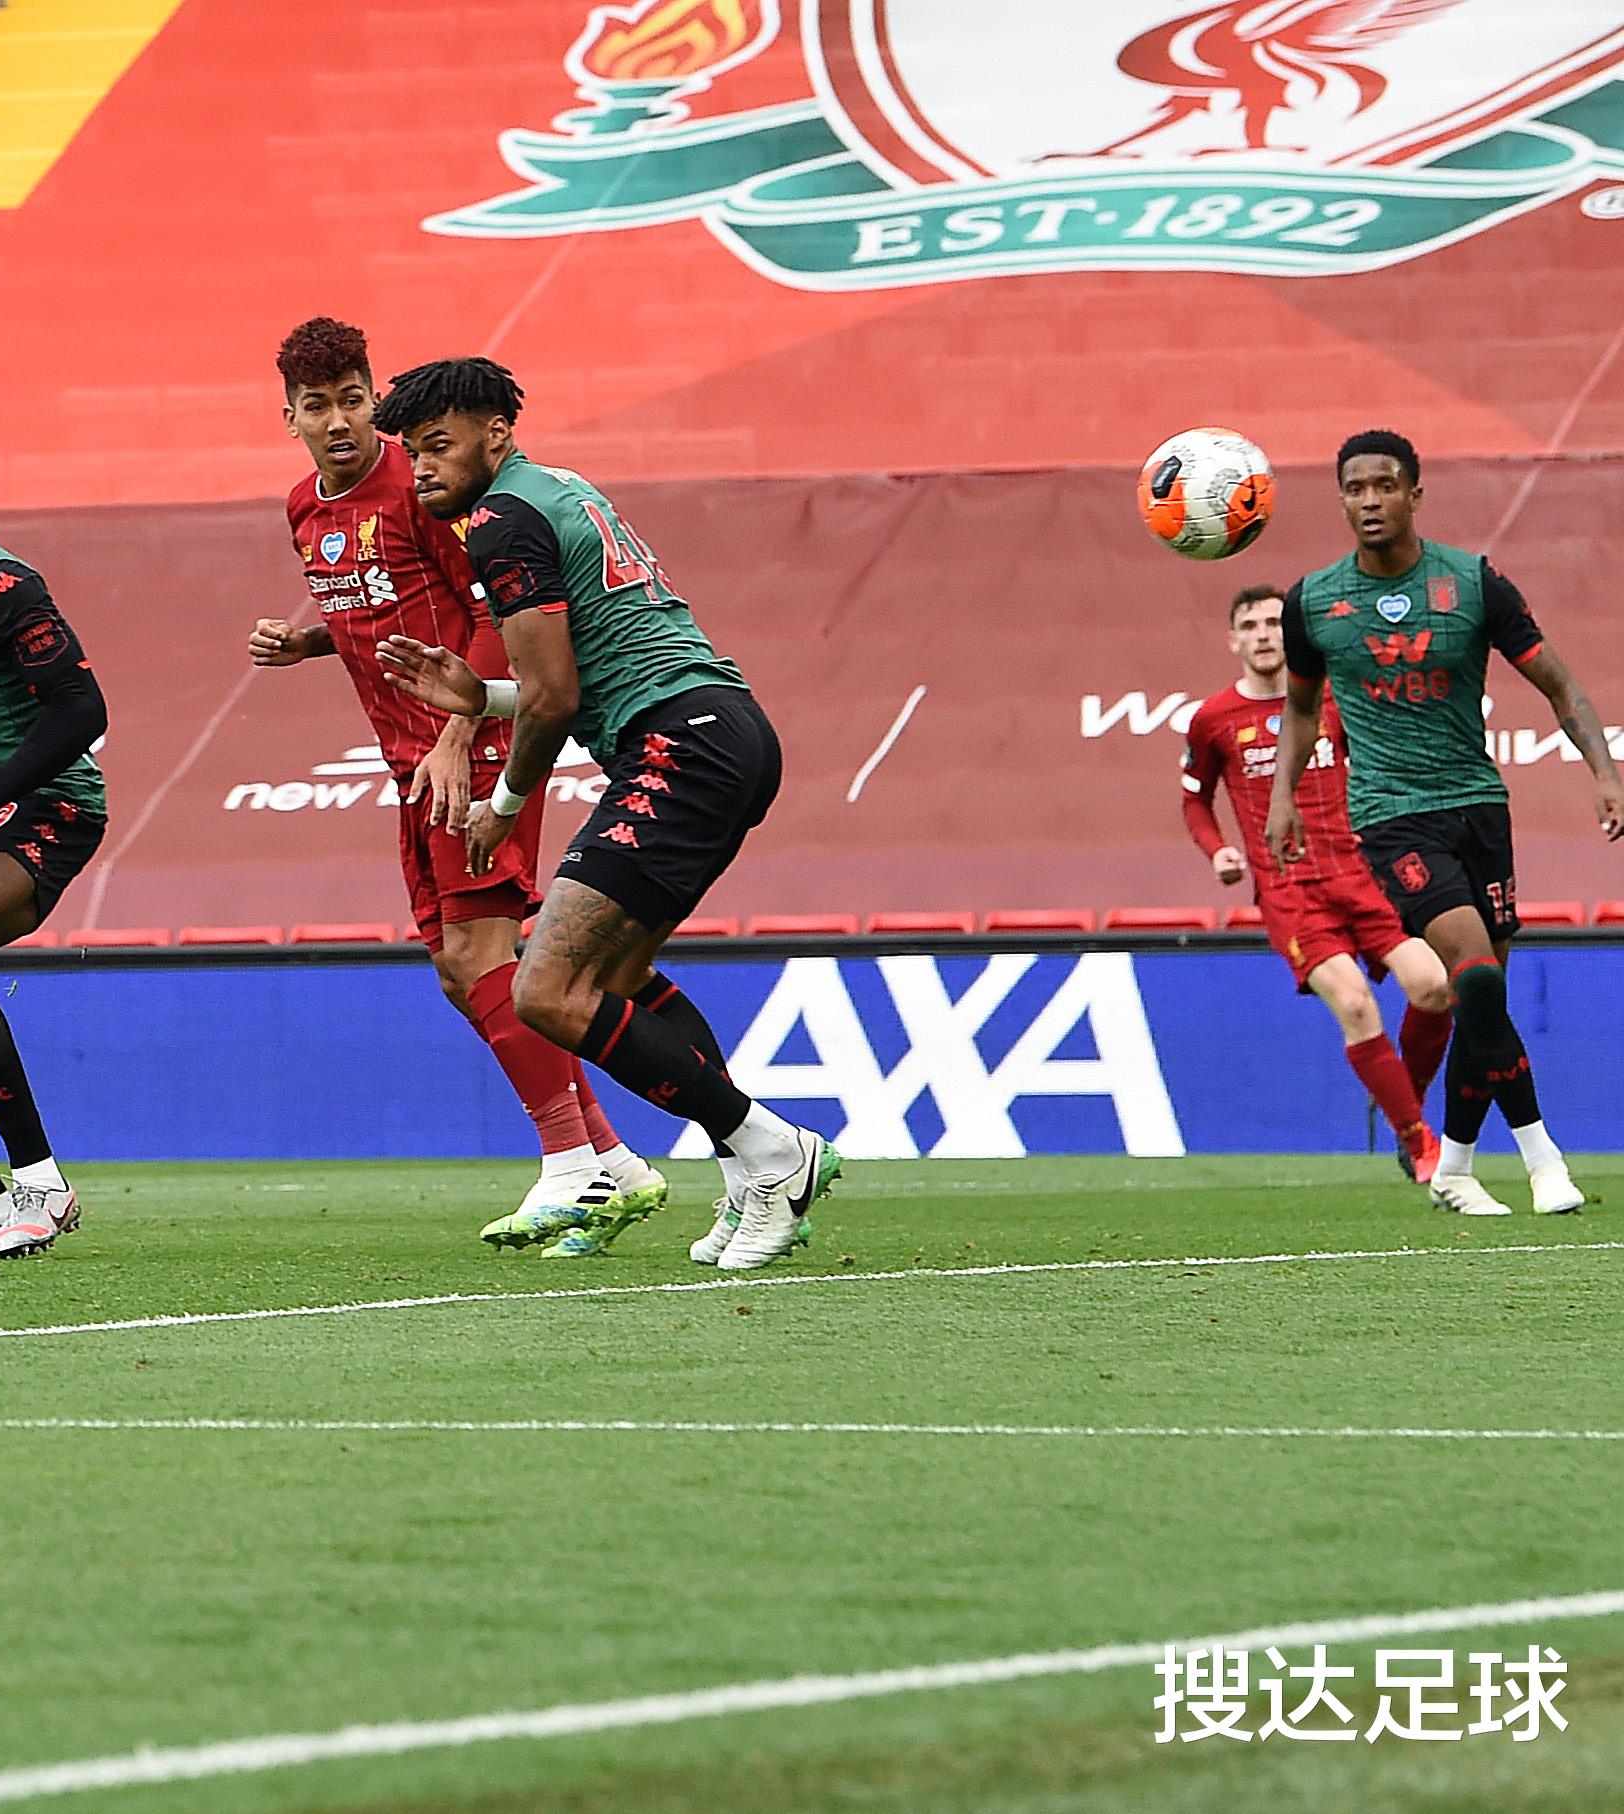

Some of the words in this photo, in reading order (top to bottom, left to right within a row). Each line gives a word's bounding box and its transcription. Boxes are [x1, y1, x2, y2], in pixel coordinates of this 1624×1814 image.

[319, 590, 368, 613] artered
[1360, 668, 1451, 704] W88
[223, 780, 374, 812] new
[668, 951, 1187, 1160] AXA
